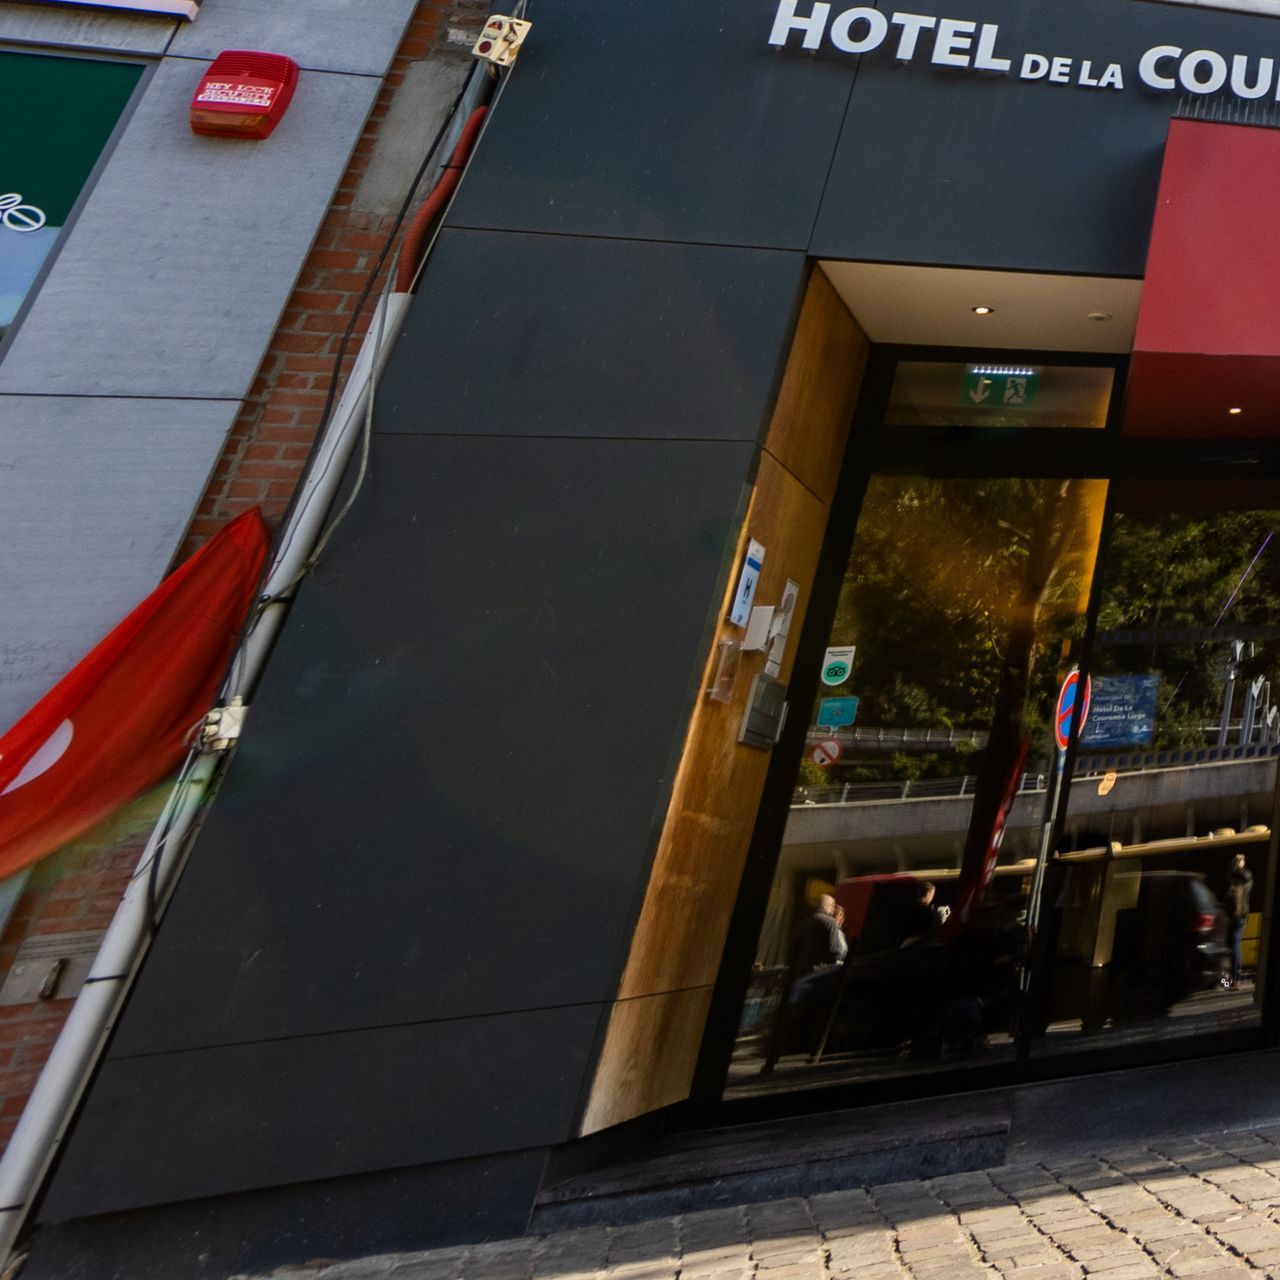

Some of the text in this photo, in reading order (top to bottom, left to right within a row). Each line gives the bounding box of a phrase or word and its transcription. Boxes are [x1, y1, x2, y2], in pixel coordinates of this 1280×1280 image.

[1019, 53, 1072, 84] DE
[1078, 60, 1124, 90] LA
[206, 82, 274, 94] KEY LOCK
